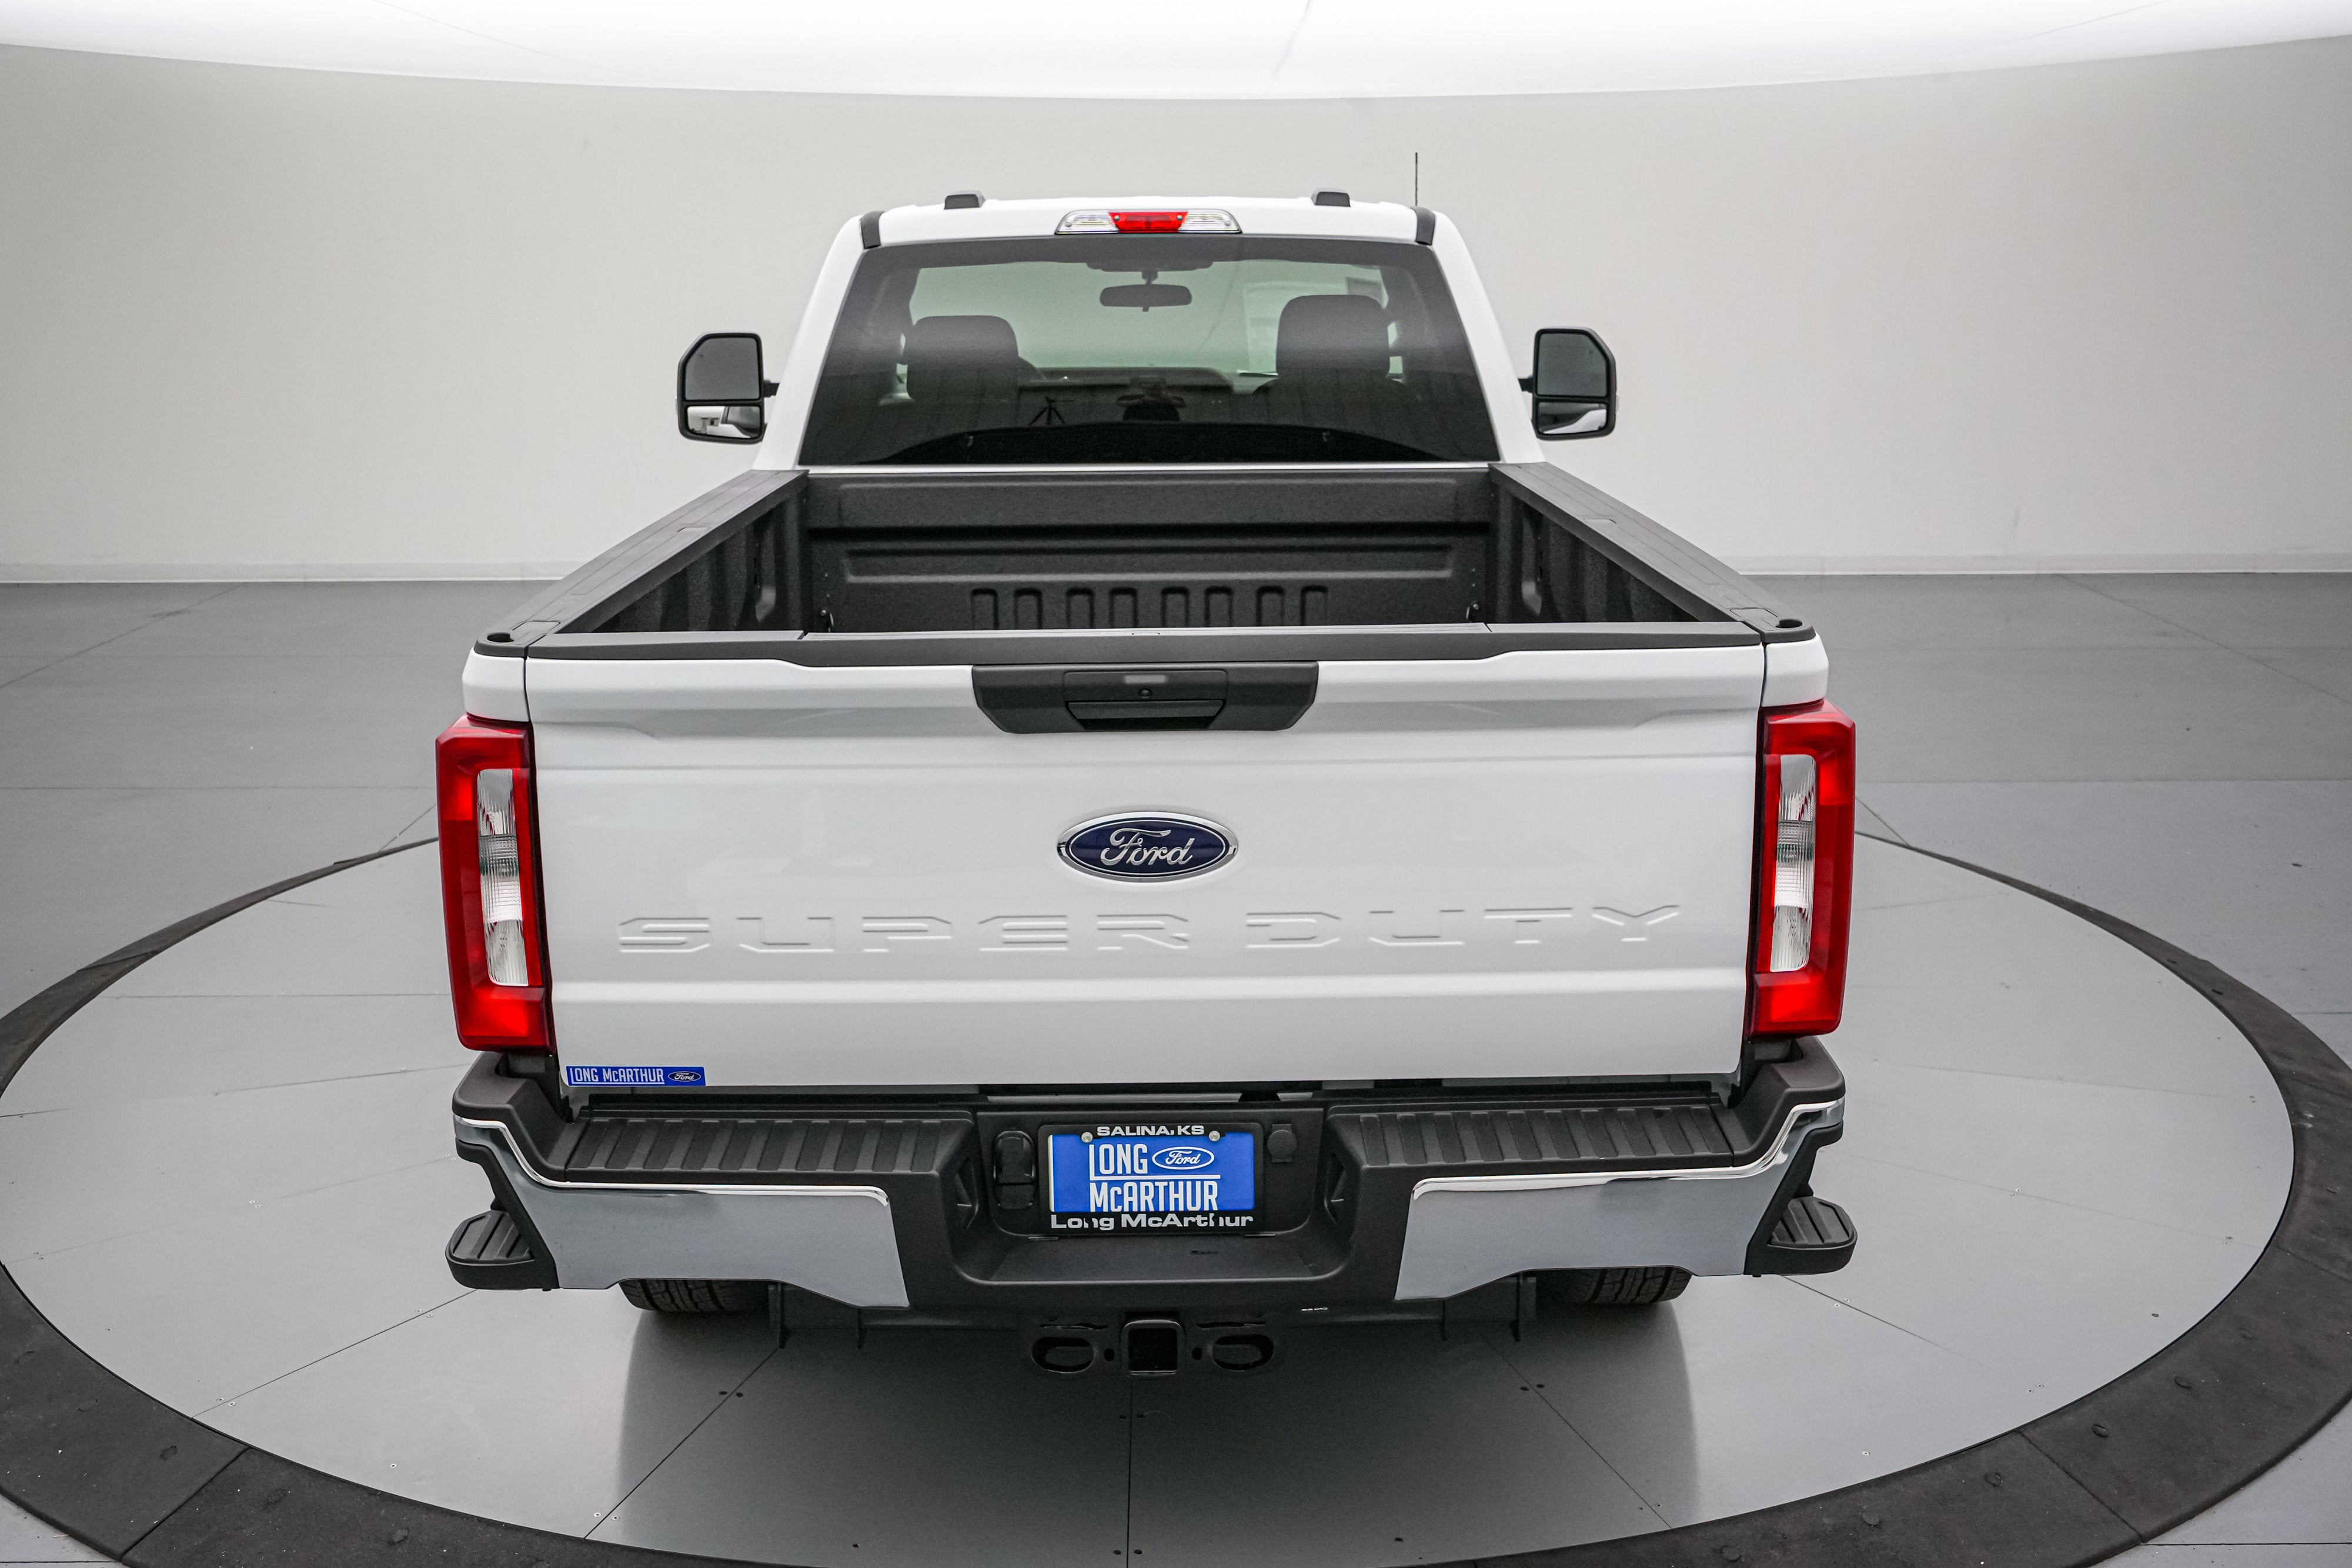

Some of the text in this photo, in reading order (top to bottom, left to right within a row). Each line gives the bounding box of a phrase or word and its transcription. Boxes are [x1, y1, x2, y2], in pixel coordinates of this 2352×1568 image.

[1100, 828, 1195, 866] Ford
[619, 905, 1679, 953] SUPER DUTY
[570, 1068, 695, 1084] LONG McARTHUR Ford
[1177, 1125, 1205, 1136] KS
[1089, 1144, 1201, 1180] LONG Ford
[1089, 1181, 1218, 1212] McARTHUR
